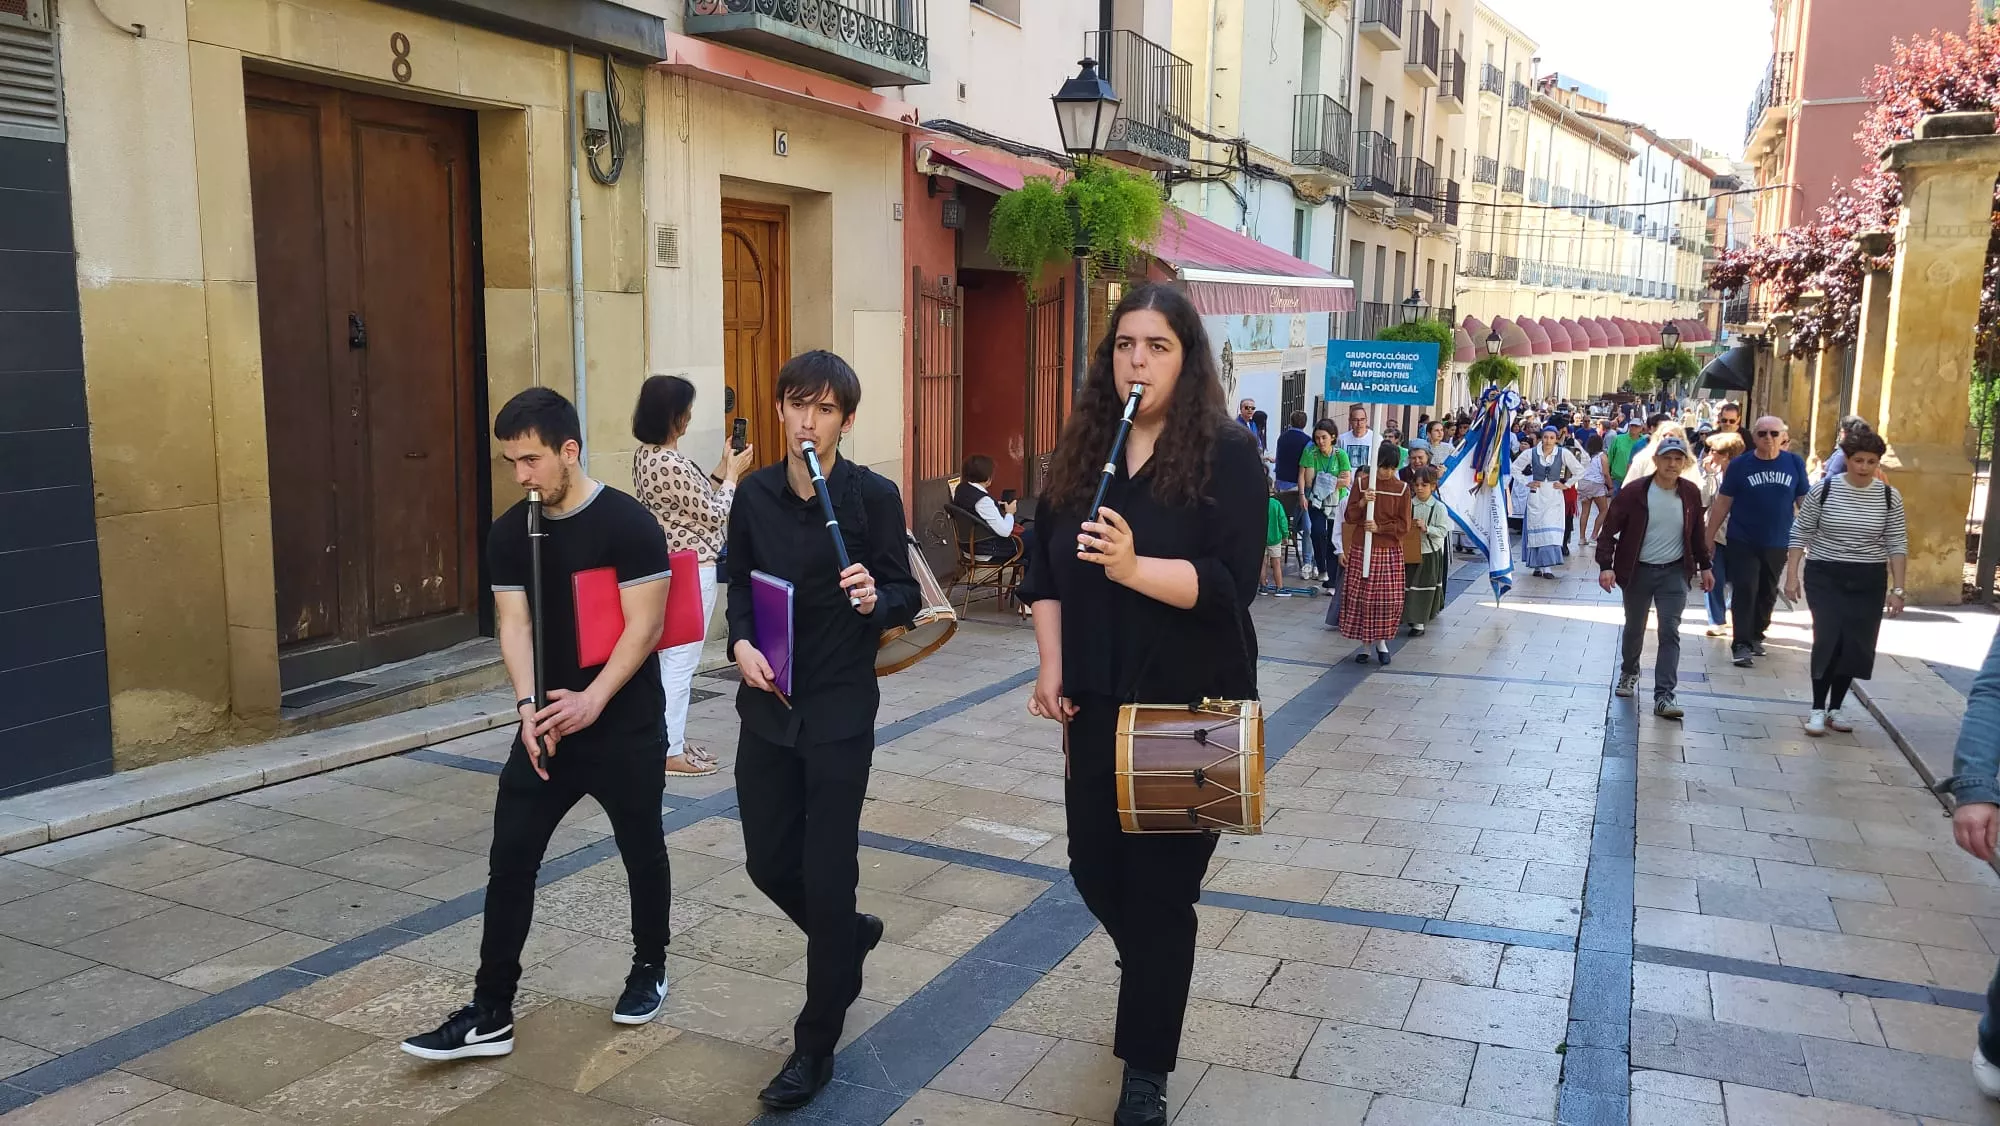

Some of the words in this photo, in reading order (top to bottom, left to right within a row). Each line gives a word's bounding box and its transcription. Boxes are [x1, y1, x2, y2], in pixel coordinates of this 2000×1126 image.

[390, 31, 412, 82] 8
[778, 133, 787, 154] 6
[1345, 351, 1371, 360] GRUPO
[1372, 351, 1420, 361] FOLCLÓRICO
[1350, 360, 1382, 369] INFANTO
[1382, 361, 1413, 370] JUVENIL
[1352, 370, 1368, 378] SAN
[1368, 370, 1392, 379] PEDRO
[1393, 371, 1410, 379] FINS
[1341, 381, 1363, 391] MAIA
[1371, 383, 1419, 394] PORTUGAL
